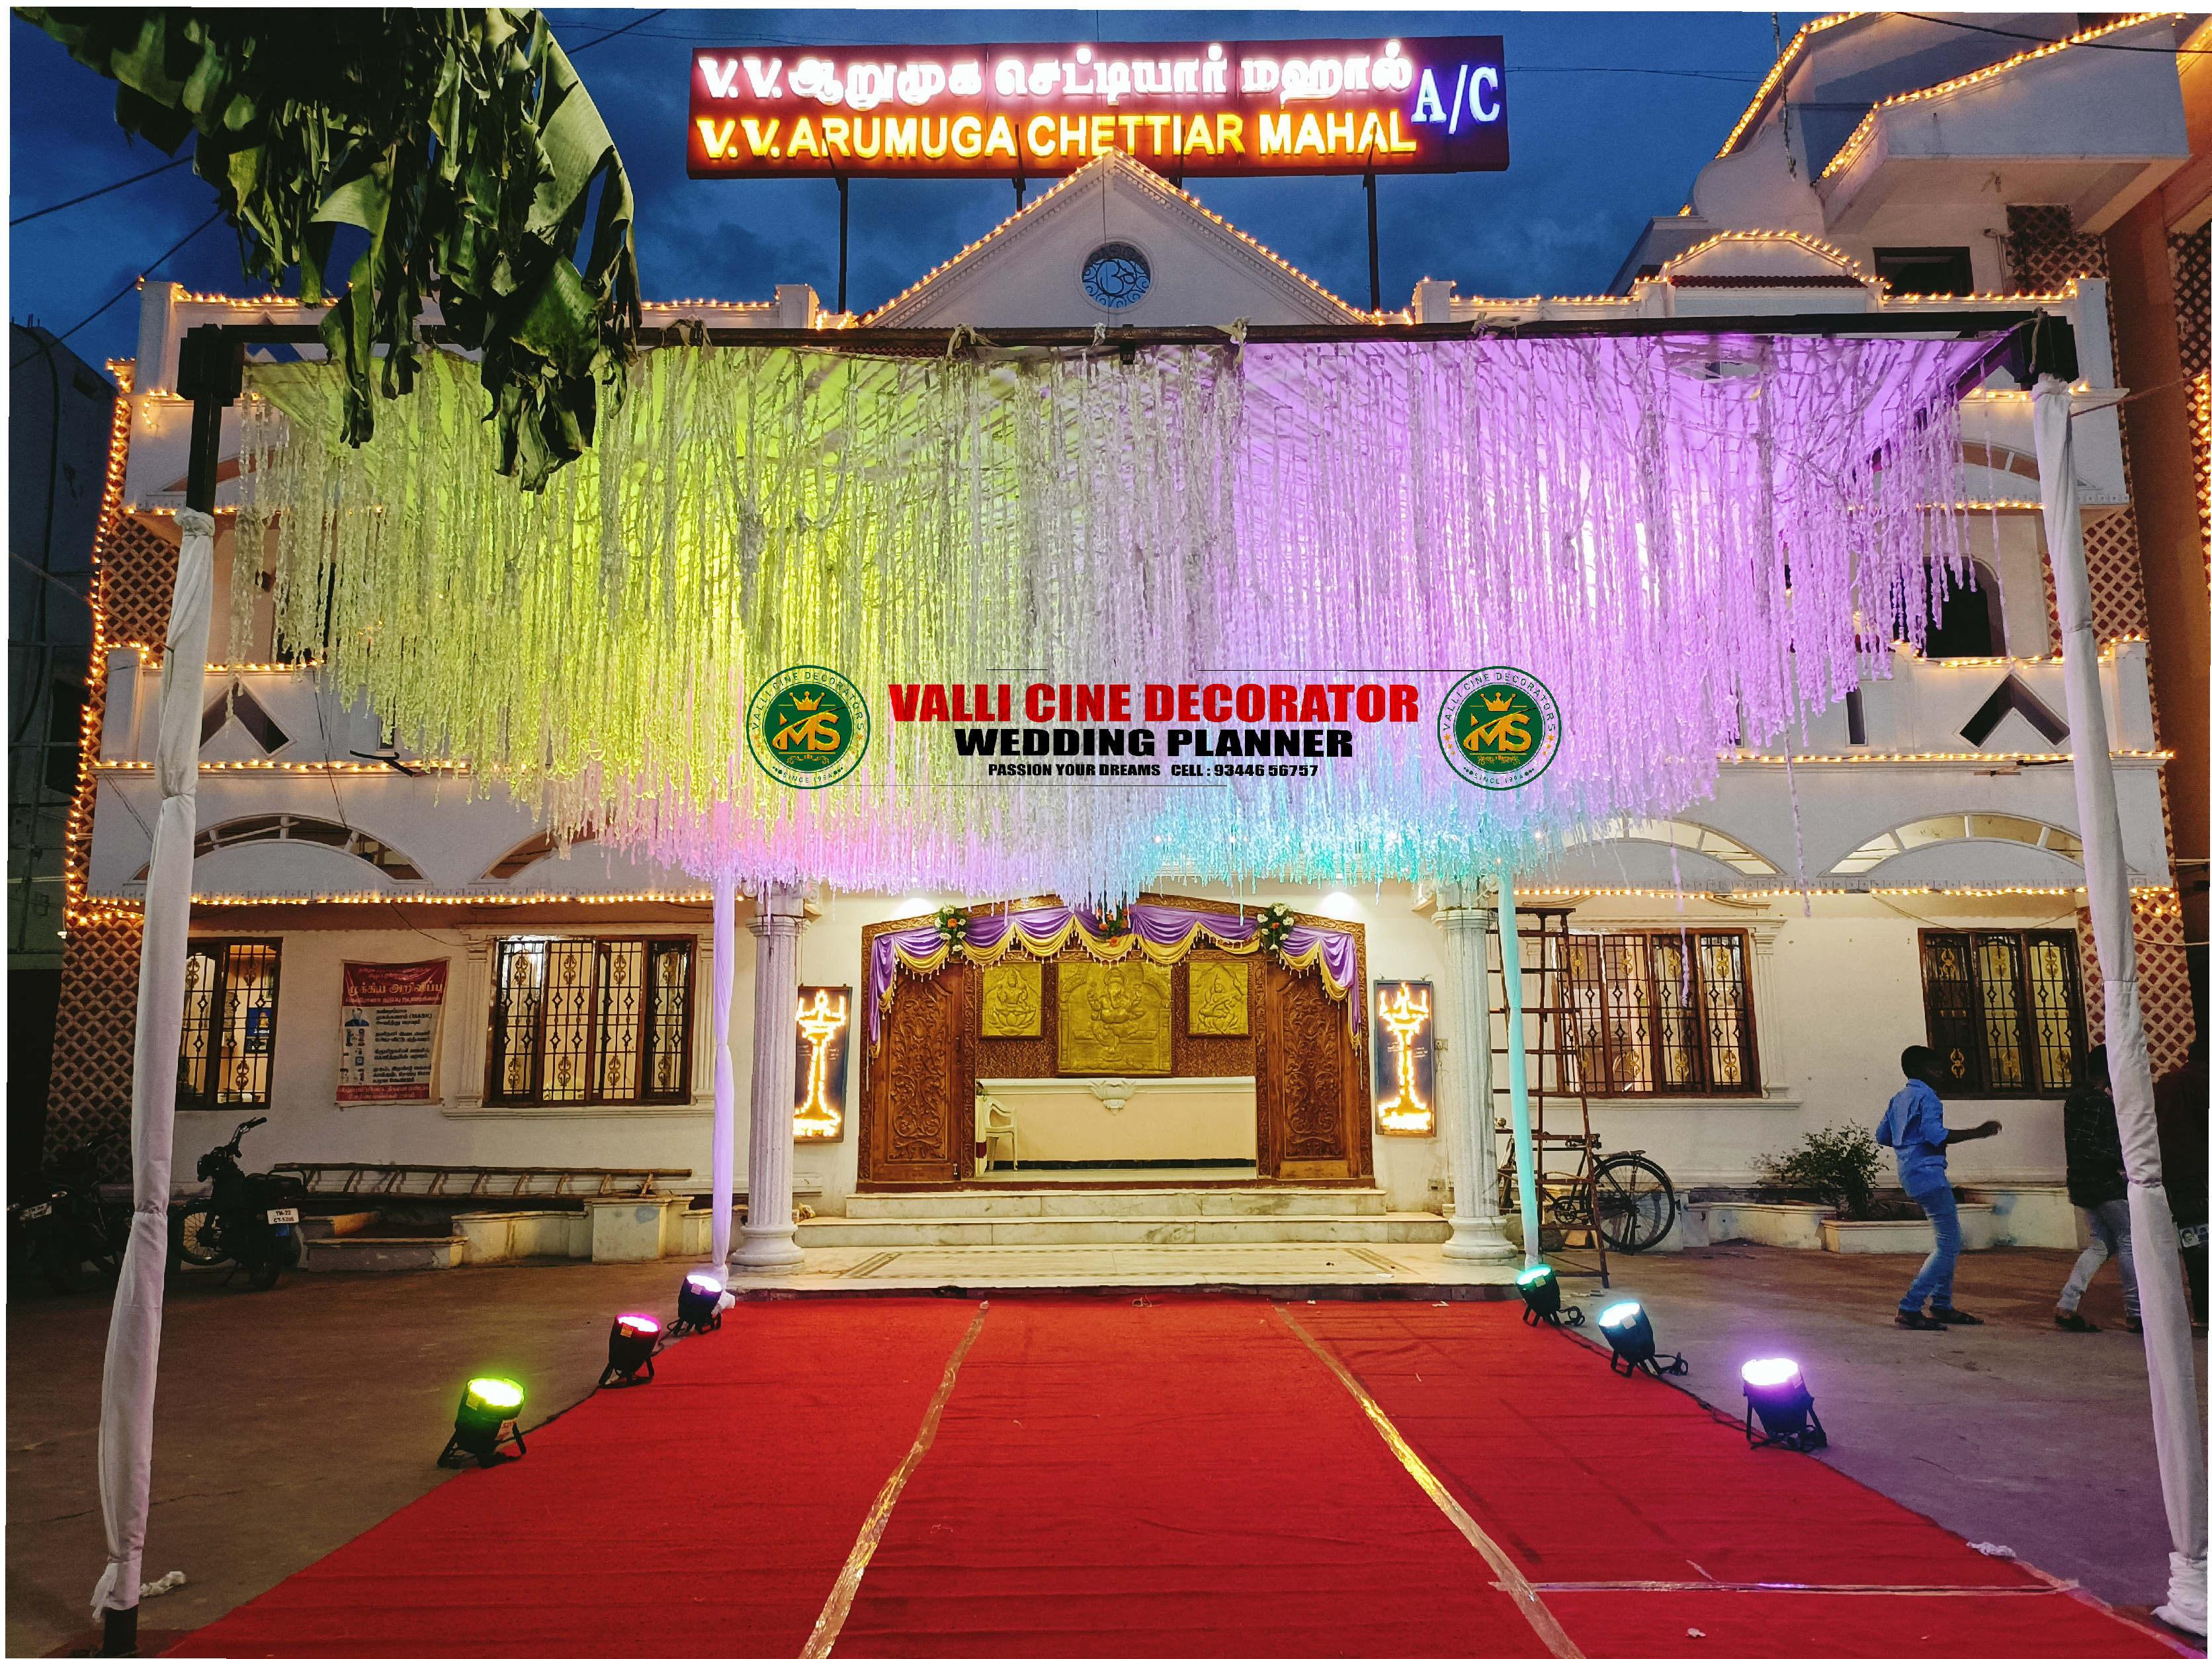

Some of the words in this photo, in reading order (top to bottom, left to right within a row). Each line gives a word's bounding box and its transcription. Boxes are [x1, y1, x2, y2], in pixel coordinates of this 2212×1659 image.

[788, 57, 981, 111] ஆறுமுக
[994, 42, 1227, 106] செட்டியார்
[1240, 39, 1413, 110] மஹால்
[1411, 64, 1501, 135] A/C
[787, 115, 1017, 159] ARUMUGA
[1027, 113, 1246, 157] CHETTIAR
[1259, 109, 1417, 155] MAHAL
